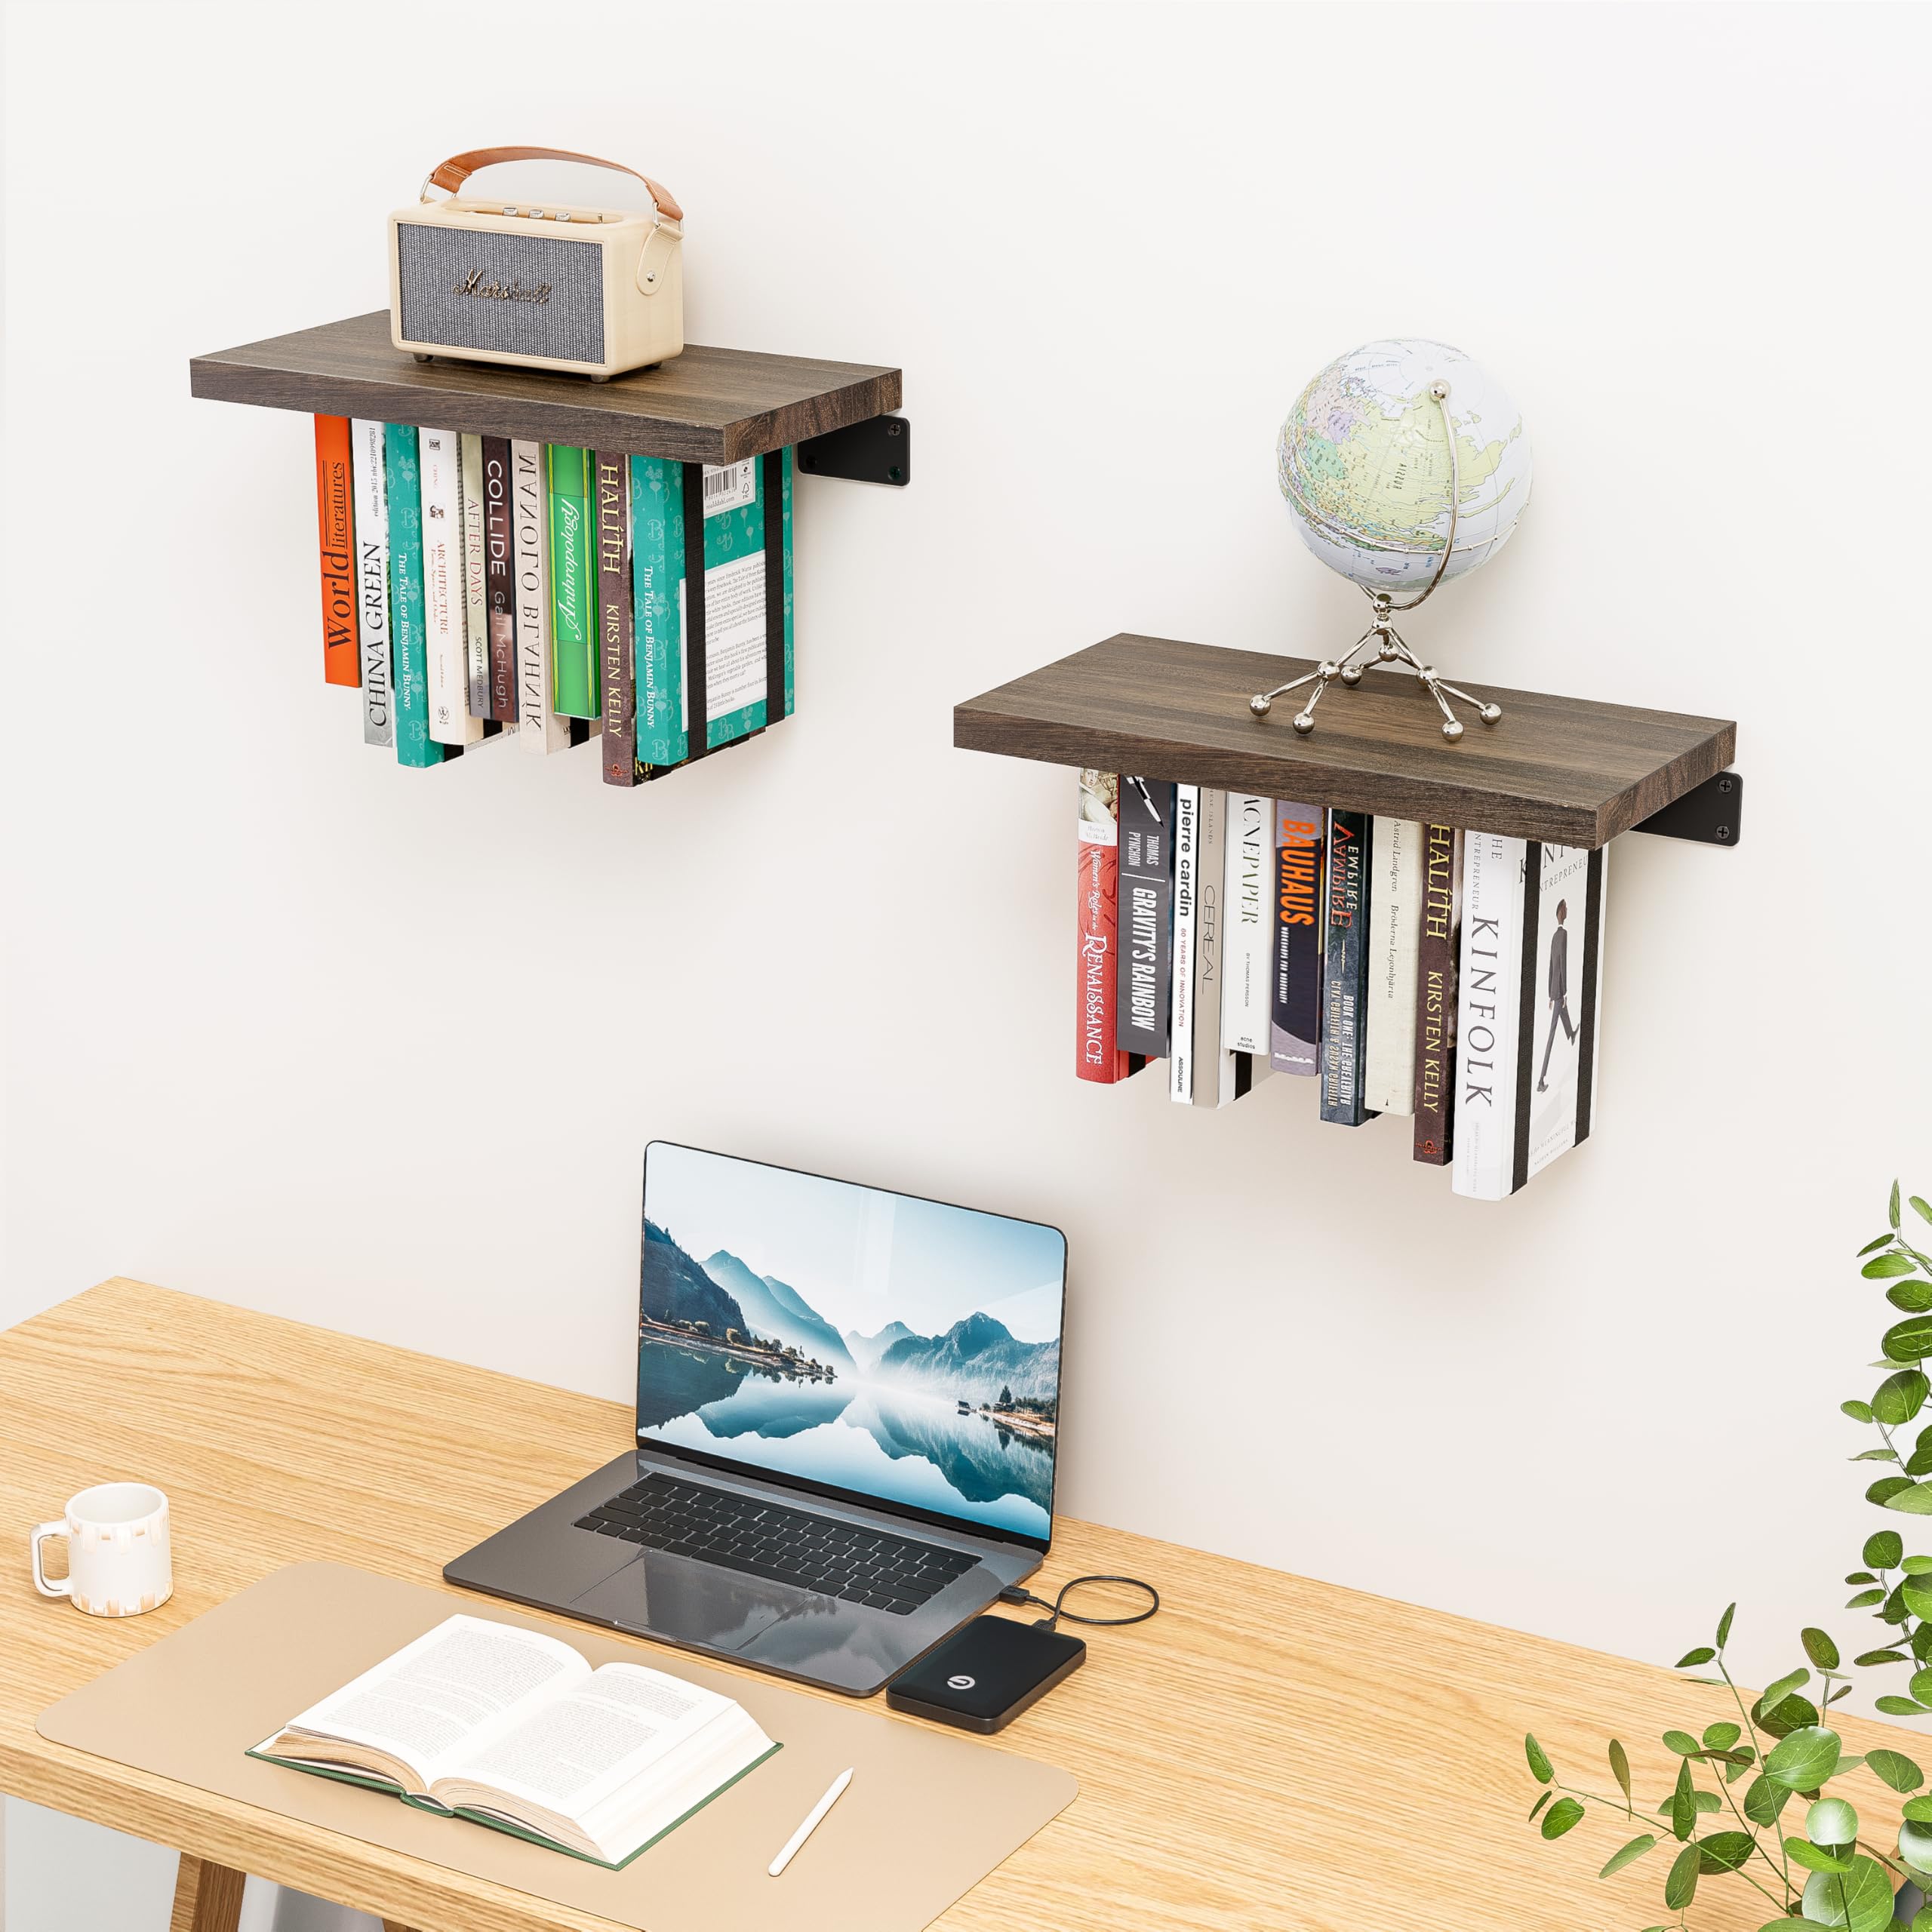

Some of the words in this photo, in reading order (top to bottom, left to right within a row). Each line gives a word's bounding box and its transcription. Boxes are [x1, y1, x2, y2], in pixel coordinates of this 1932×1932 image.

[453, 269, 552, 303] Marshall
[331, 462, 345, 549] literatures
[468, 498, 481, 555] AFTER
[488, 460, 506, 577] COLLIDE
[363, 541, 383, 630] GREEN
[398, 553, 408, 574] THE
[436, 542, 448, 635] ARCHITECTURE
[469, 562, 483, 606] DAYS
[557, 498, 581, 641] Anthropology
[644, 567, 654, 588] THE
[323, 551, 352, 650] World
[399, 577, 408, 603] TALE
[400, 605, 408, 620] OF
[494, 591, 505, 626] Gail
[645, 591, 654, 617] TALE
[400, 620, 410, 672] BENJAMIN
[606, 604, 621, 680] KIRSTEN
[645, 619, 653, 634] OF
[368, 641, 386, 727] CHINA
[495, 633, 509, 708] McHugh
[645, 635, 654, 689] BENJAMIN
[608, 686, 622, 738] KELLY
[1128, 832, 1141, 867] PYNCHON
[1146, 835, 1160, 866] THOMAS
[1180, 798, 1194, 853] pierre
[1392, 820, 1401, 850] Astrid
[1491, 838, 1503, 860] HE
[1090, 851, 1102, 888] Women's
[1241, 798, 1261, 924] ACNEPAPER
[1279, 818, 1316, 926] BAUHAUS
[1389, 851, 1401, 892] Lindgren
[1472, 833, 1481, 910] NTREPRENEUR
[1540, 855, 1588, 894] NTREPRENEU
[1088, 890, 1102, 914] Roles
[1180, 859, 1192, 917] cardin
[1132, 888, 1157, 962] GRAVITY'S
[1180, 928, 1186, 937] 60
[1202, 884, 1216, 995] CEREAL
[1389, 905, 1399, 945] Bröderna
[1131, 962, 1156, 1032] RAINBOW
[1180, 967, 1186, 978] OF
[1387, 947, 1398, 998] Lejonhjärta
[1081, 933, 1107, 1066] RENAISSANCE
[1426, 970, 1443, 1052] KIRSTEN
[1466, 914, 1499, 1108] KINFOLK
[1237, 1041, 1256, 1050] studios
[1423, 1058, 1440, 1113] KELLY
